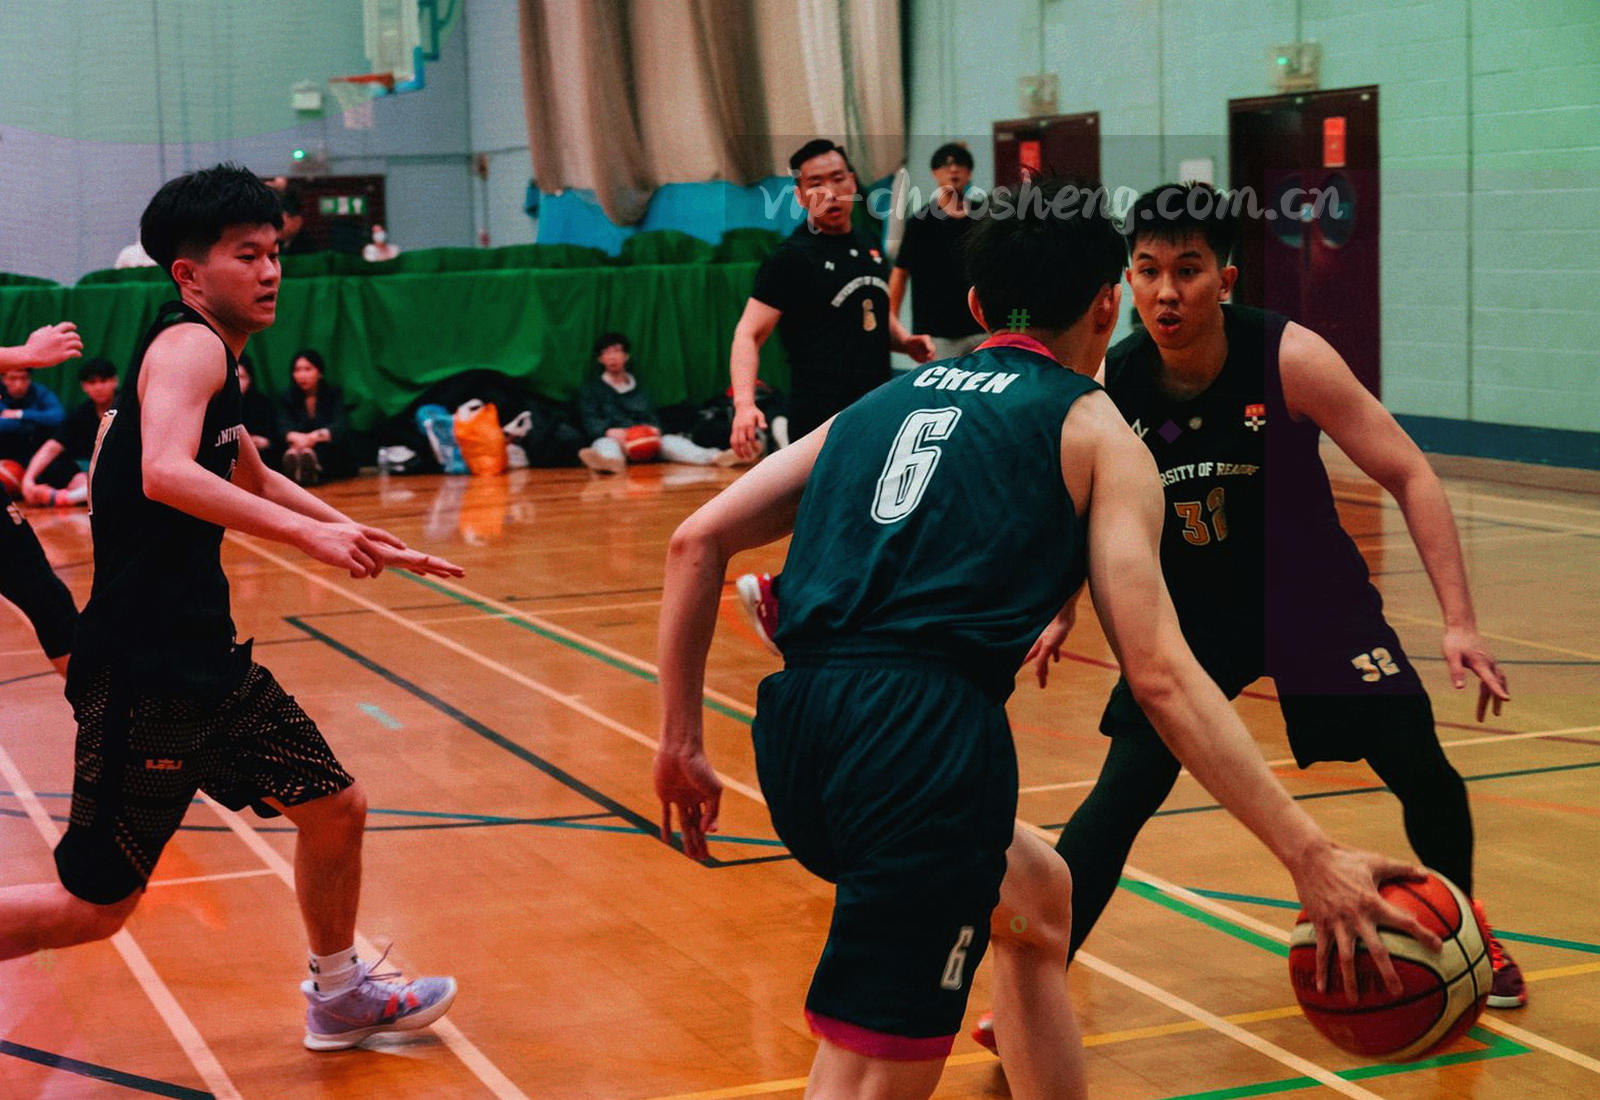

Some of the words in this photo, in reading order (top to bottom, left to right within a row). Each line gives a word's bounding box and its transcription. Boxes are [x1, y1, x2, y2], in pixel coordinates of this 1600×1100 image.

[913, 365, 1020, 394] CHEN
[870, 406, 963, 525] 6
[1198, 462, 1214, 477] OF
[1351, 647, 1400, 682] 32
[940, 924, 975, 990] 6
